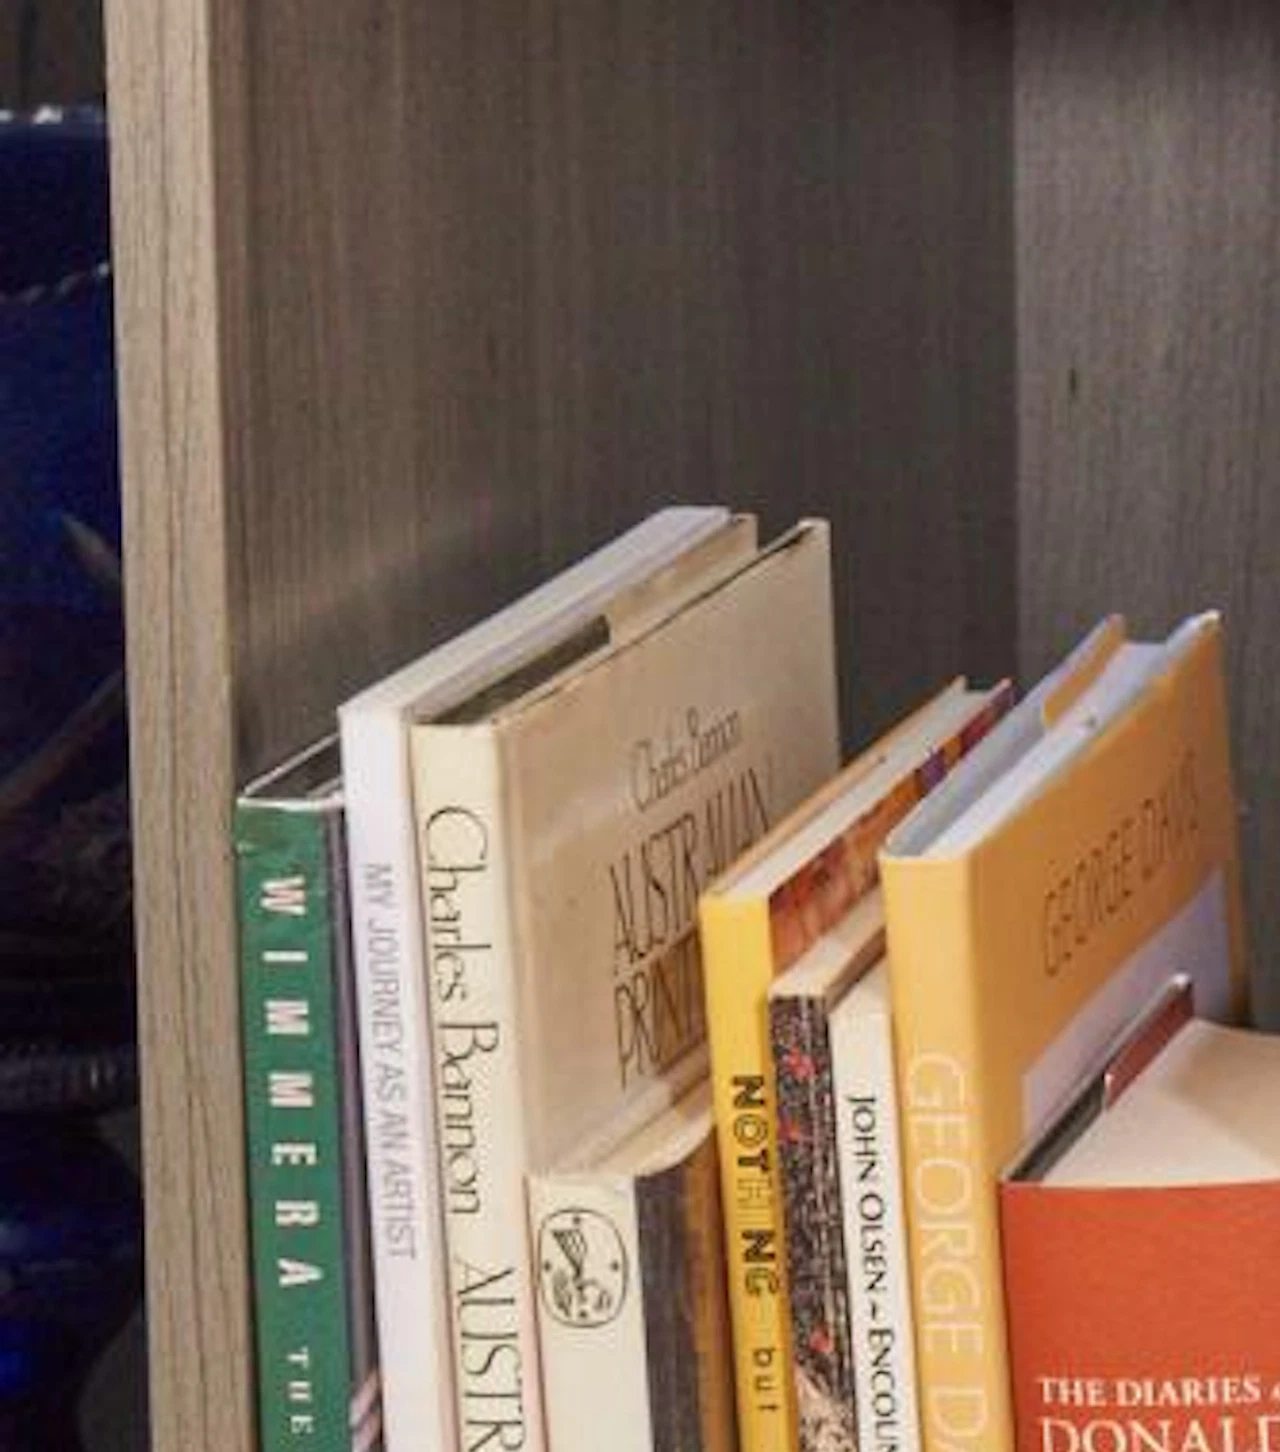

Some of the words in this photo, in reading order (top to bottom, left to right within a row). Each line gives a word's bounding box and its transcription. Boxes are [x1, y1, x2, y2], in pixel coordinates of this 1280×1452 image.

[366, 864, 395, 909] MY
[426, 806, 492, 1003] Charles
[370, 918, 402, 1052] JOURNEY
[261, 874, 324, 1289] WIMMERA
[376, 1063, 404, 1101] AS
[379, 1111, 408, 1151] AN
[437, 1020, 500, 1215] Bannon
[731, 1074, 778, 1298] NOTHING
[847, 1094, 880, 1182] JOHN
[383, 1158, 416, 1260] ARTIST
[860, 1193, 888, 1292] OLSEN
[905, 1051, 982, 1354] GEORGE
[288, 1346, 318, 1433] THE
[752, 1349, 778, 1413] but
[1038, 1376, 1106, 1406] THE
[1115, 1374, 1261, 1406] DIARIES
